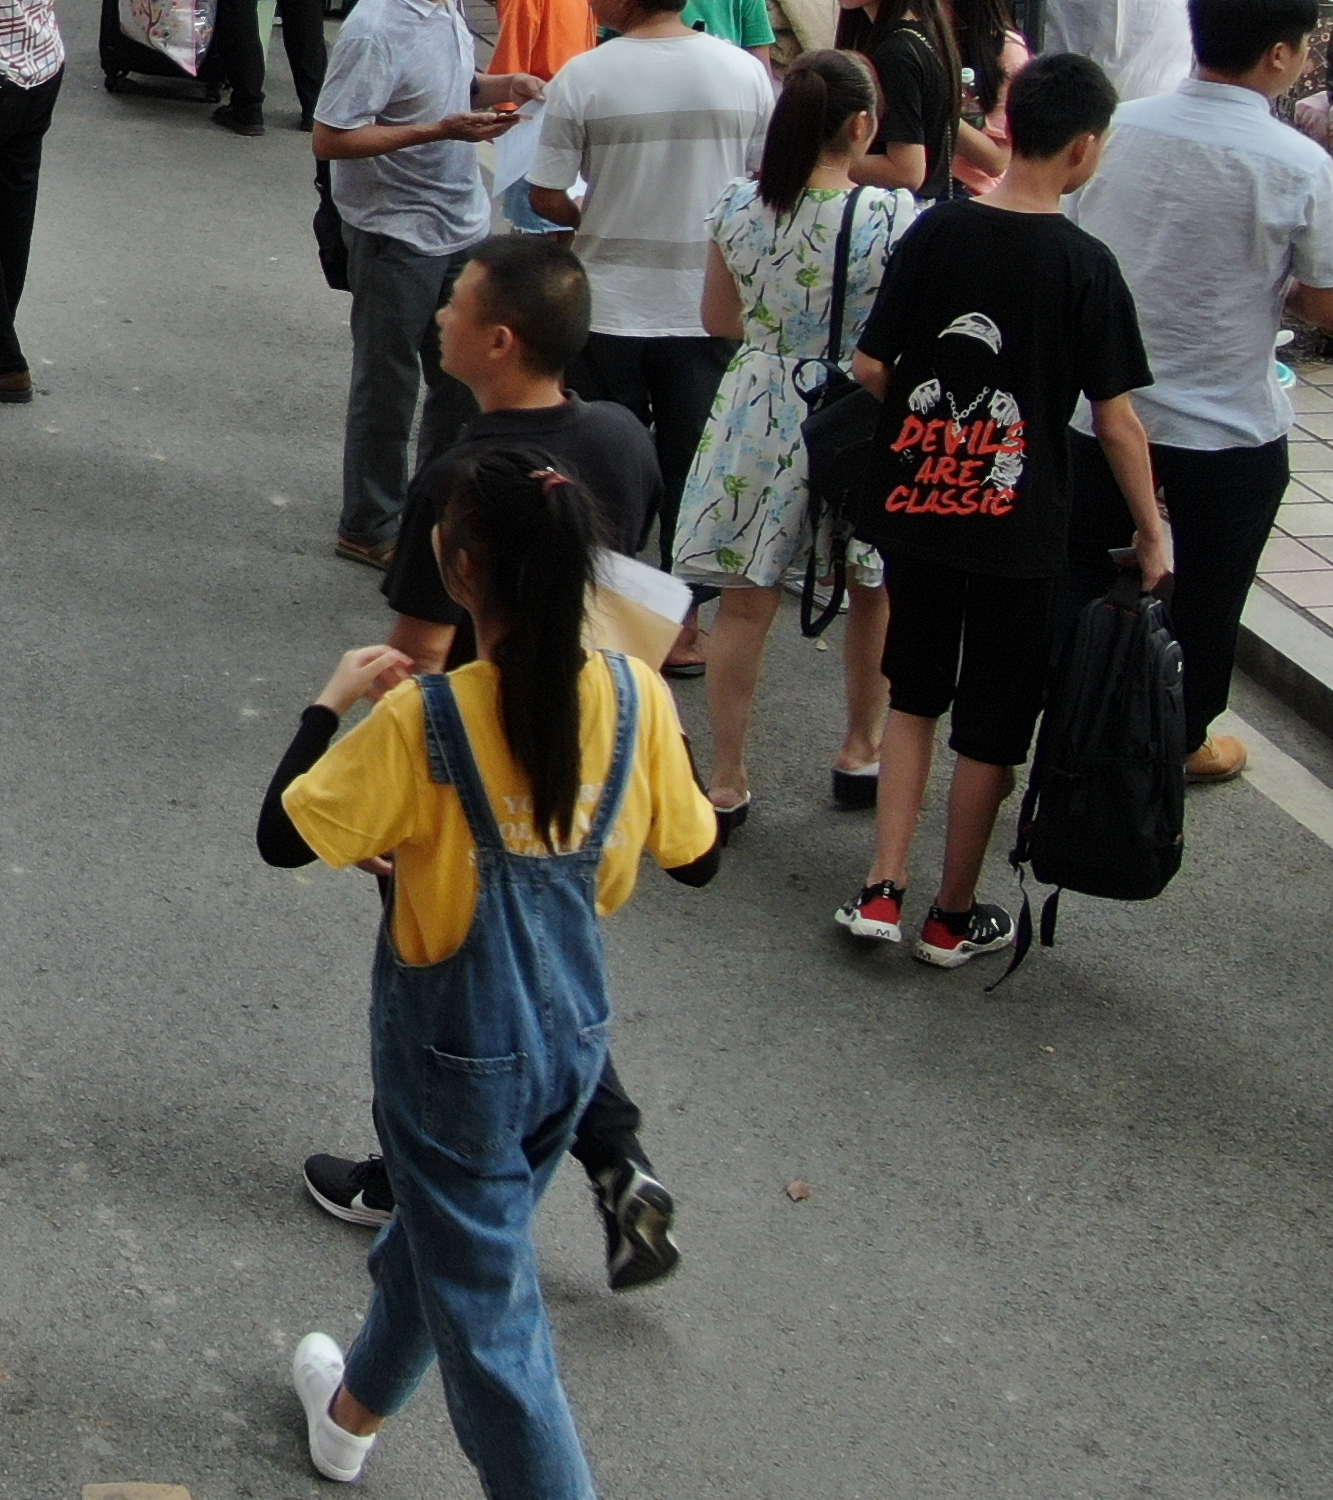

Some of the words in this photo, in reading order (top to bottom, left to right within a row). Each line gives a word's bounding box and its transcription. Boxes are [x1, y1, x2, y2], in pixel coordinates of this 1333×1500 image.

[890, 414, 1029, 454] DEVILS
[914, 456, 985, 487] ARE
[885, 485, 1017, 516] CLASSIC
